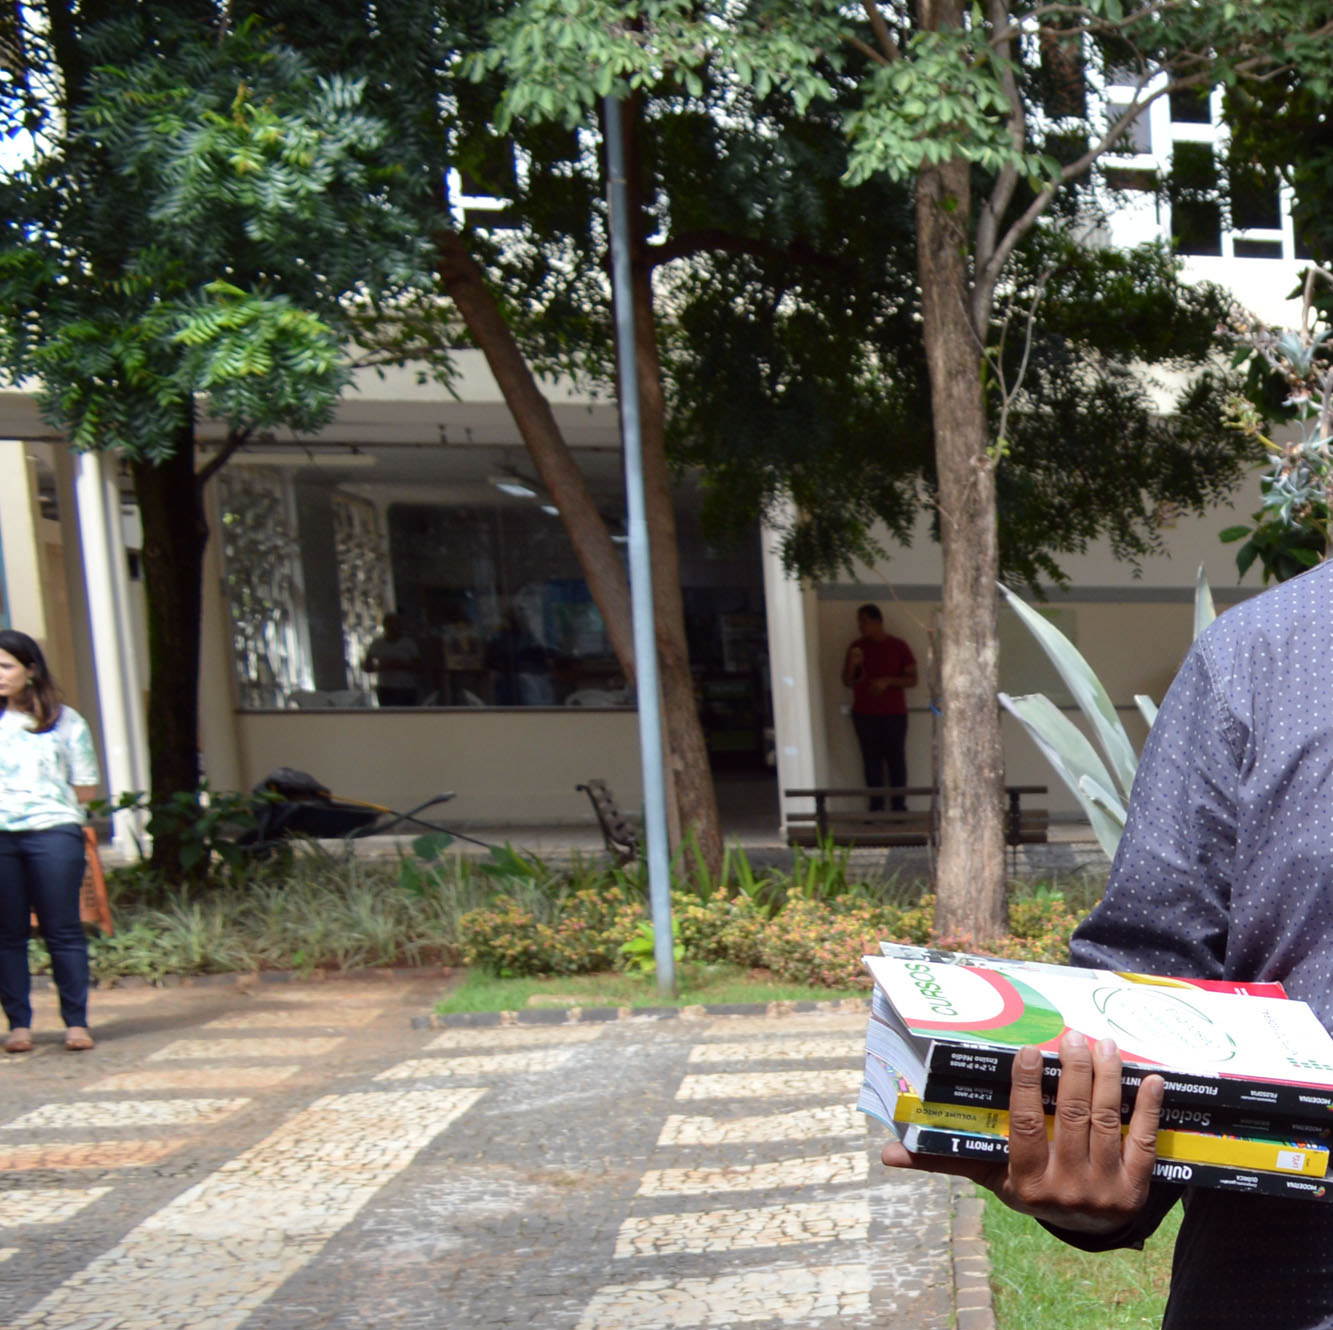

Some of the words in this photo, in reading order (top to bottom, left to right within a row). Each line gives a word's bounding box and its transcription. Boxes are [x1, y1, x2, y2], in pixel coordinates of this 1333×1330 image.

[905, 963, 958, 1016] CURSOS
[951, 1053, 974, 1062] Médio
[974, 1055, 998, 1064] Ensino
[950, 1060, 966, 1068] anos
[1163, 1081, 1219, 1096] FILOSOFAND
[1299, 1095, 1331, 1105] MODERNA
[944, 1110, 977, 1121] VOLUME
[1159, 1109, 1212, 1126] Sociolo
[951, 1137, 961, 1152] 1
[965, 1139, 994, 1151] PROTI
[1153, 1164, 1193, 1180] QUÍMI
[1287, 1181, 1318, 1191] MODERNA
